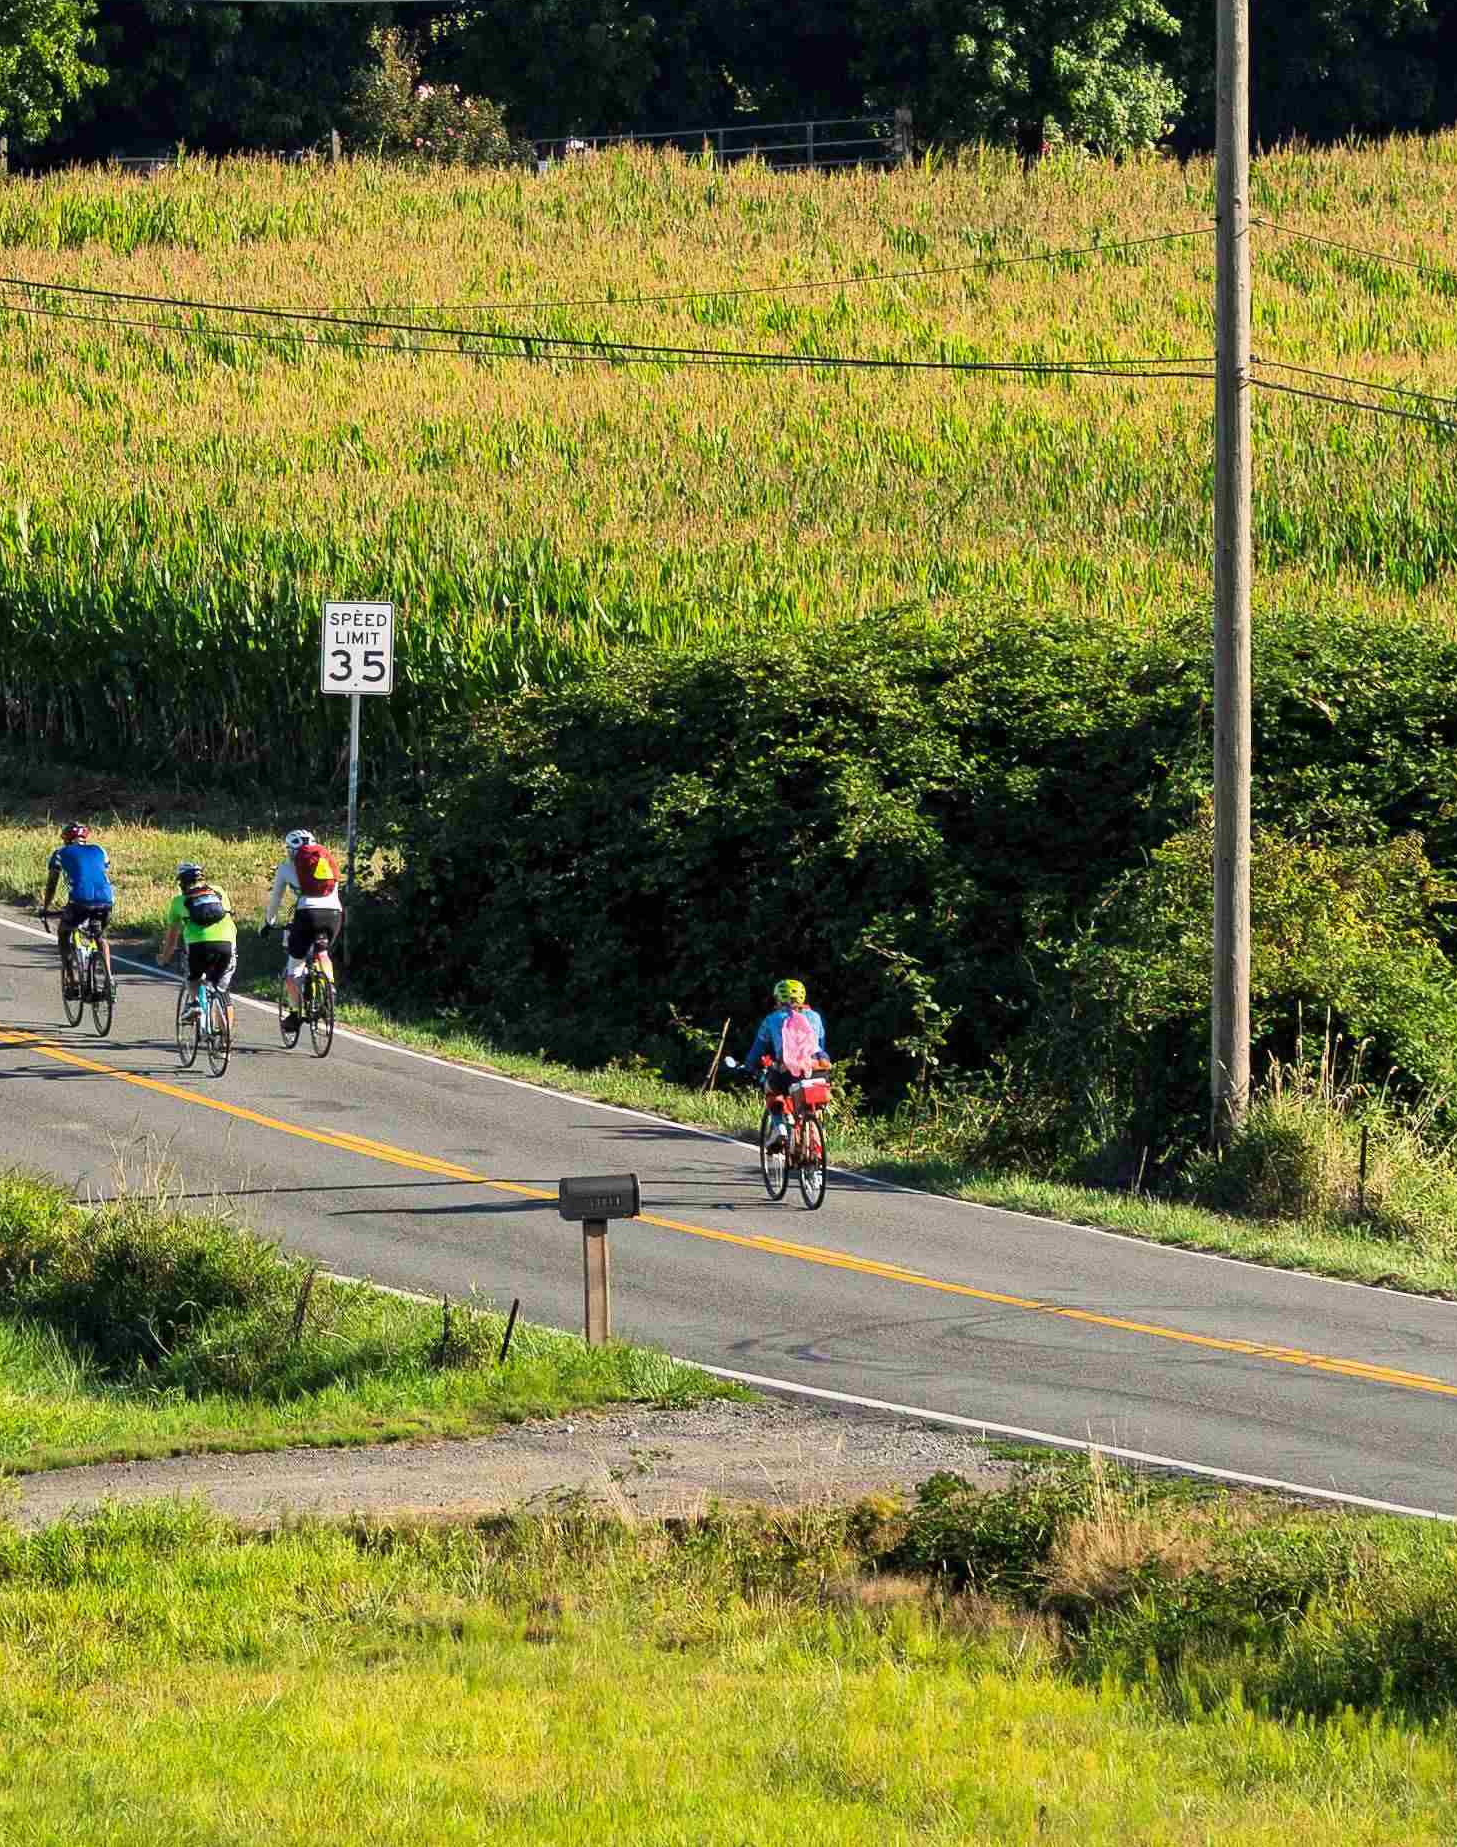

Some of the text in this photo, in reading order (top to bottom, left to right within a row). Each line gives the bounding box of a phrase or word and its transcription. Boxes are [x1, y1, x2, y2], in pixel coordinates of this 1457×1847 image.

[329, 612, 387, 626] SPEED
[335, 631, 380, 645] LIMIT
[329, 649, 386, 683] 35
